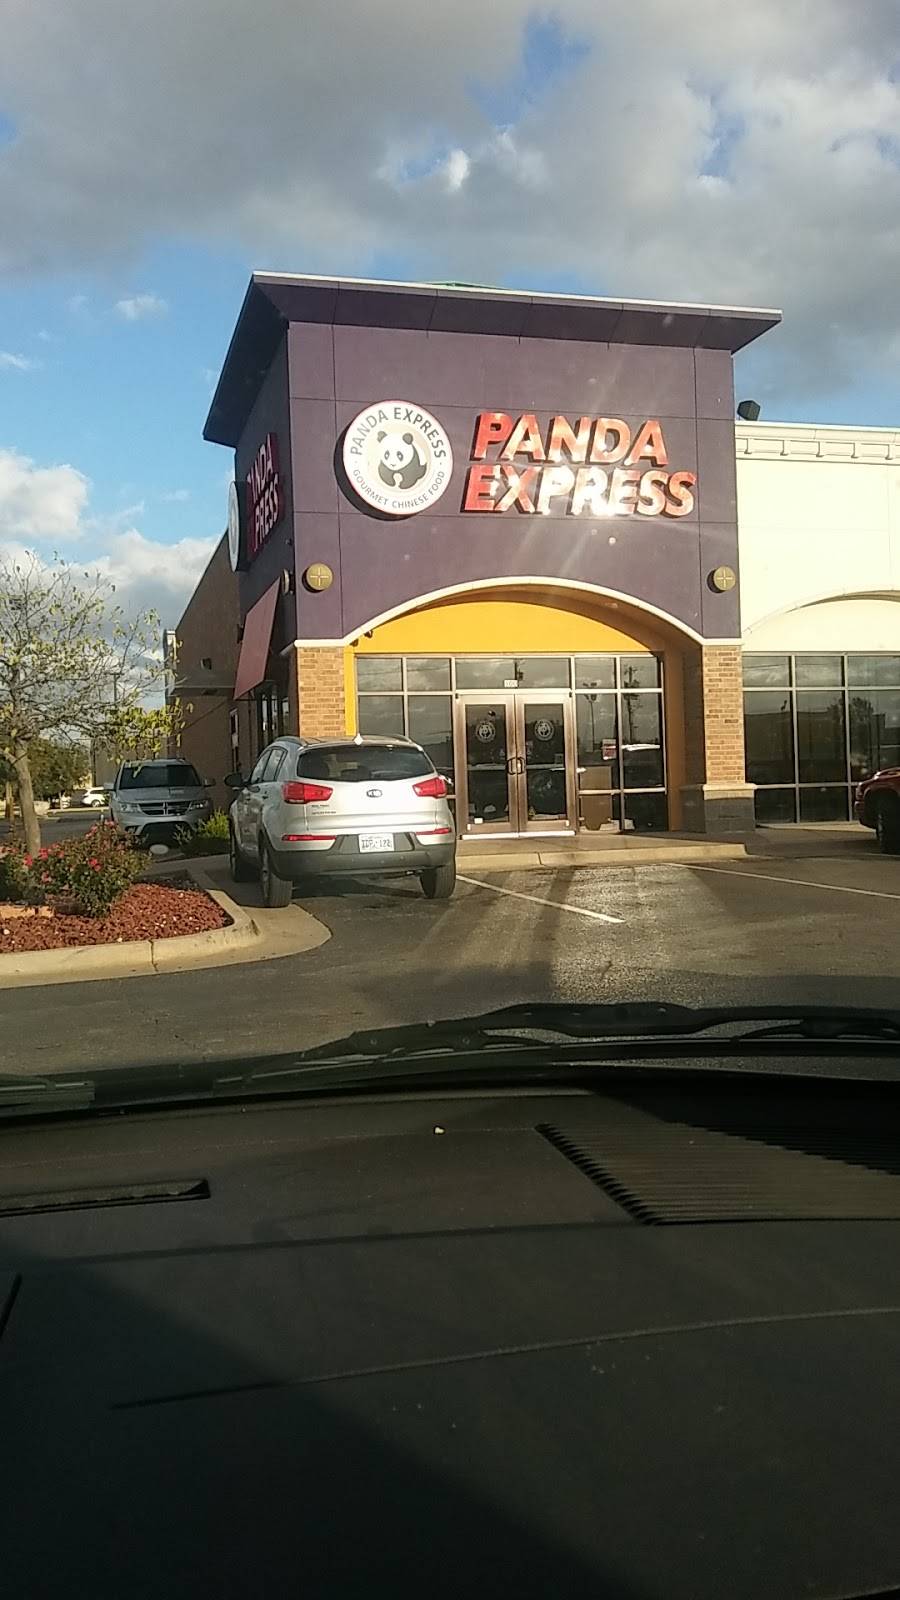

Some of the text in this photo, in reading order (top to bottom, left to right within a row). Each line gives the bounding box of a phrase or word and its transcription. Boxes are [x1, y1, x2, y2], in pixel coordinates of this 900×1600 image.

[350, 407, 446, 458] PANDA EXPRESS
[472, 412, 669, 466] PANDA
[353, 469, 445, 509] GOURMET CHINESE FOOD
[463, 464, 697, 517] EXPRESS
